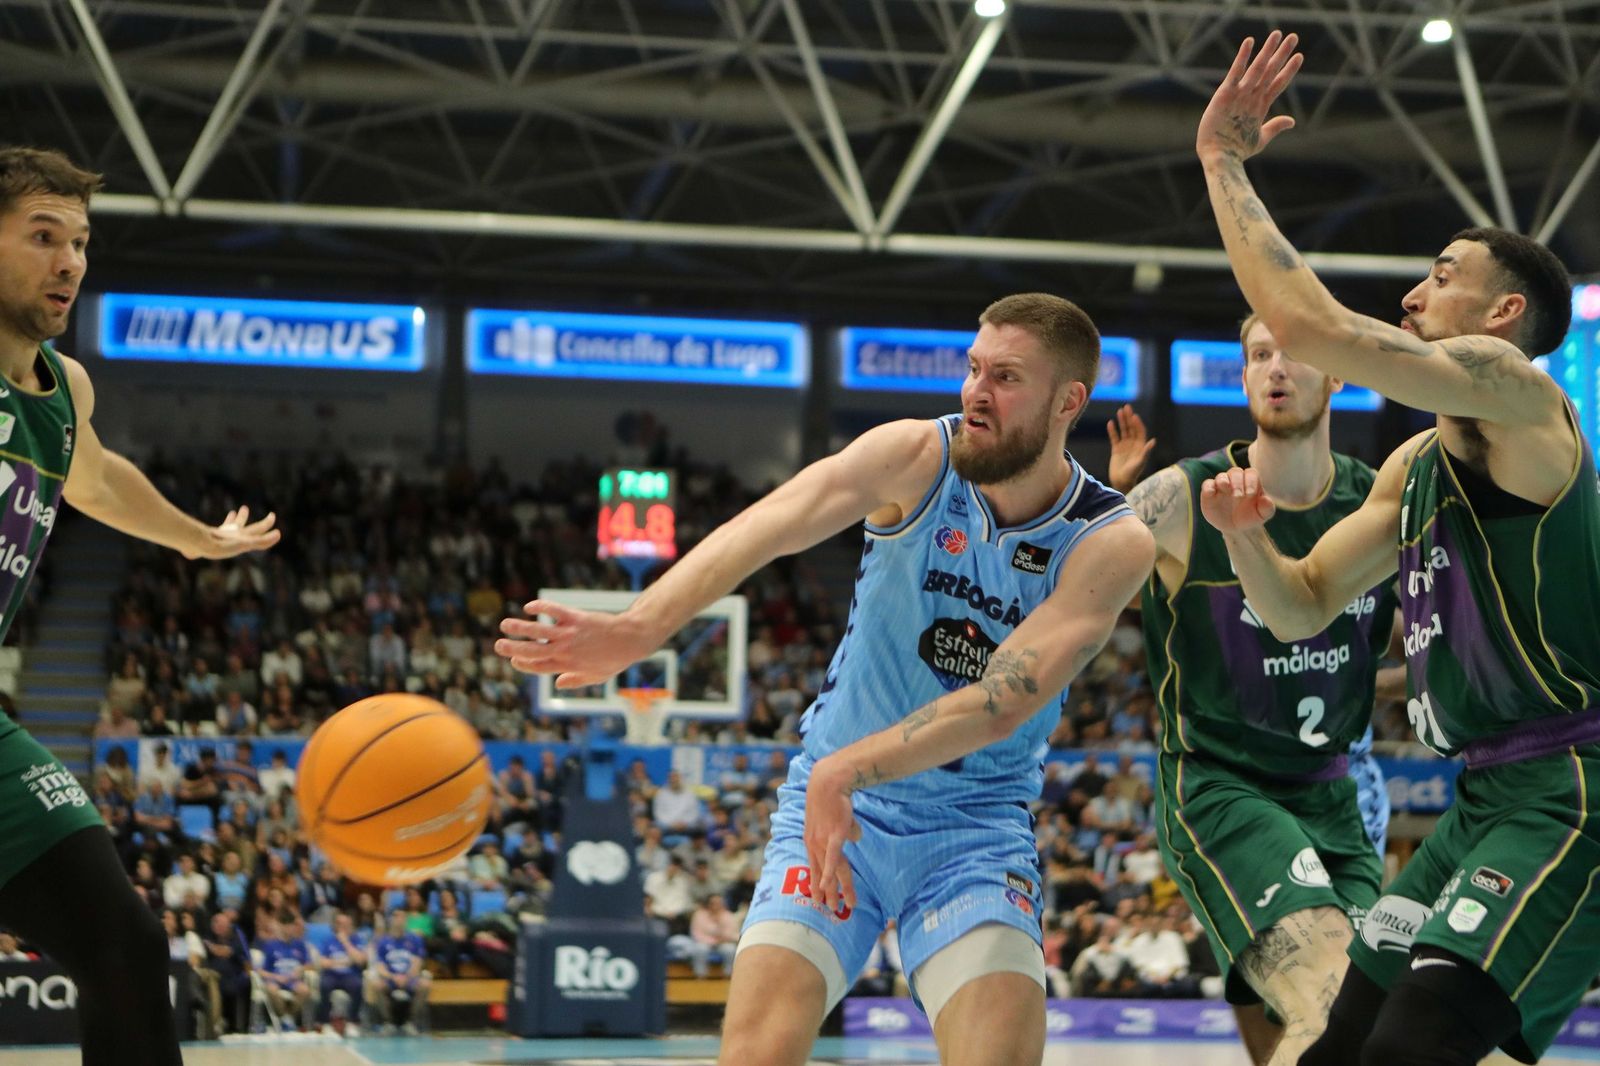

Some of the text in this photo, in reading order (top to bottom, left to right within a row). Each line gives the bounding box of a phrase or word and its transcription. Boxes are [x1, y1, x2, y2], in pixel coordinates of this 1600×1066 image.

[1014, 558, 1046, 572] endesa
[923, 569, 1027, 628] BREOGÁ
[934, 647, 983, 679] Galici
[1297, 696, 1330, 747] 2
